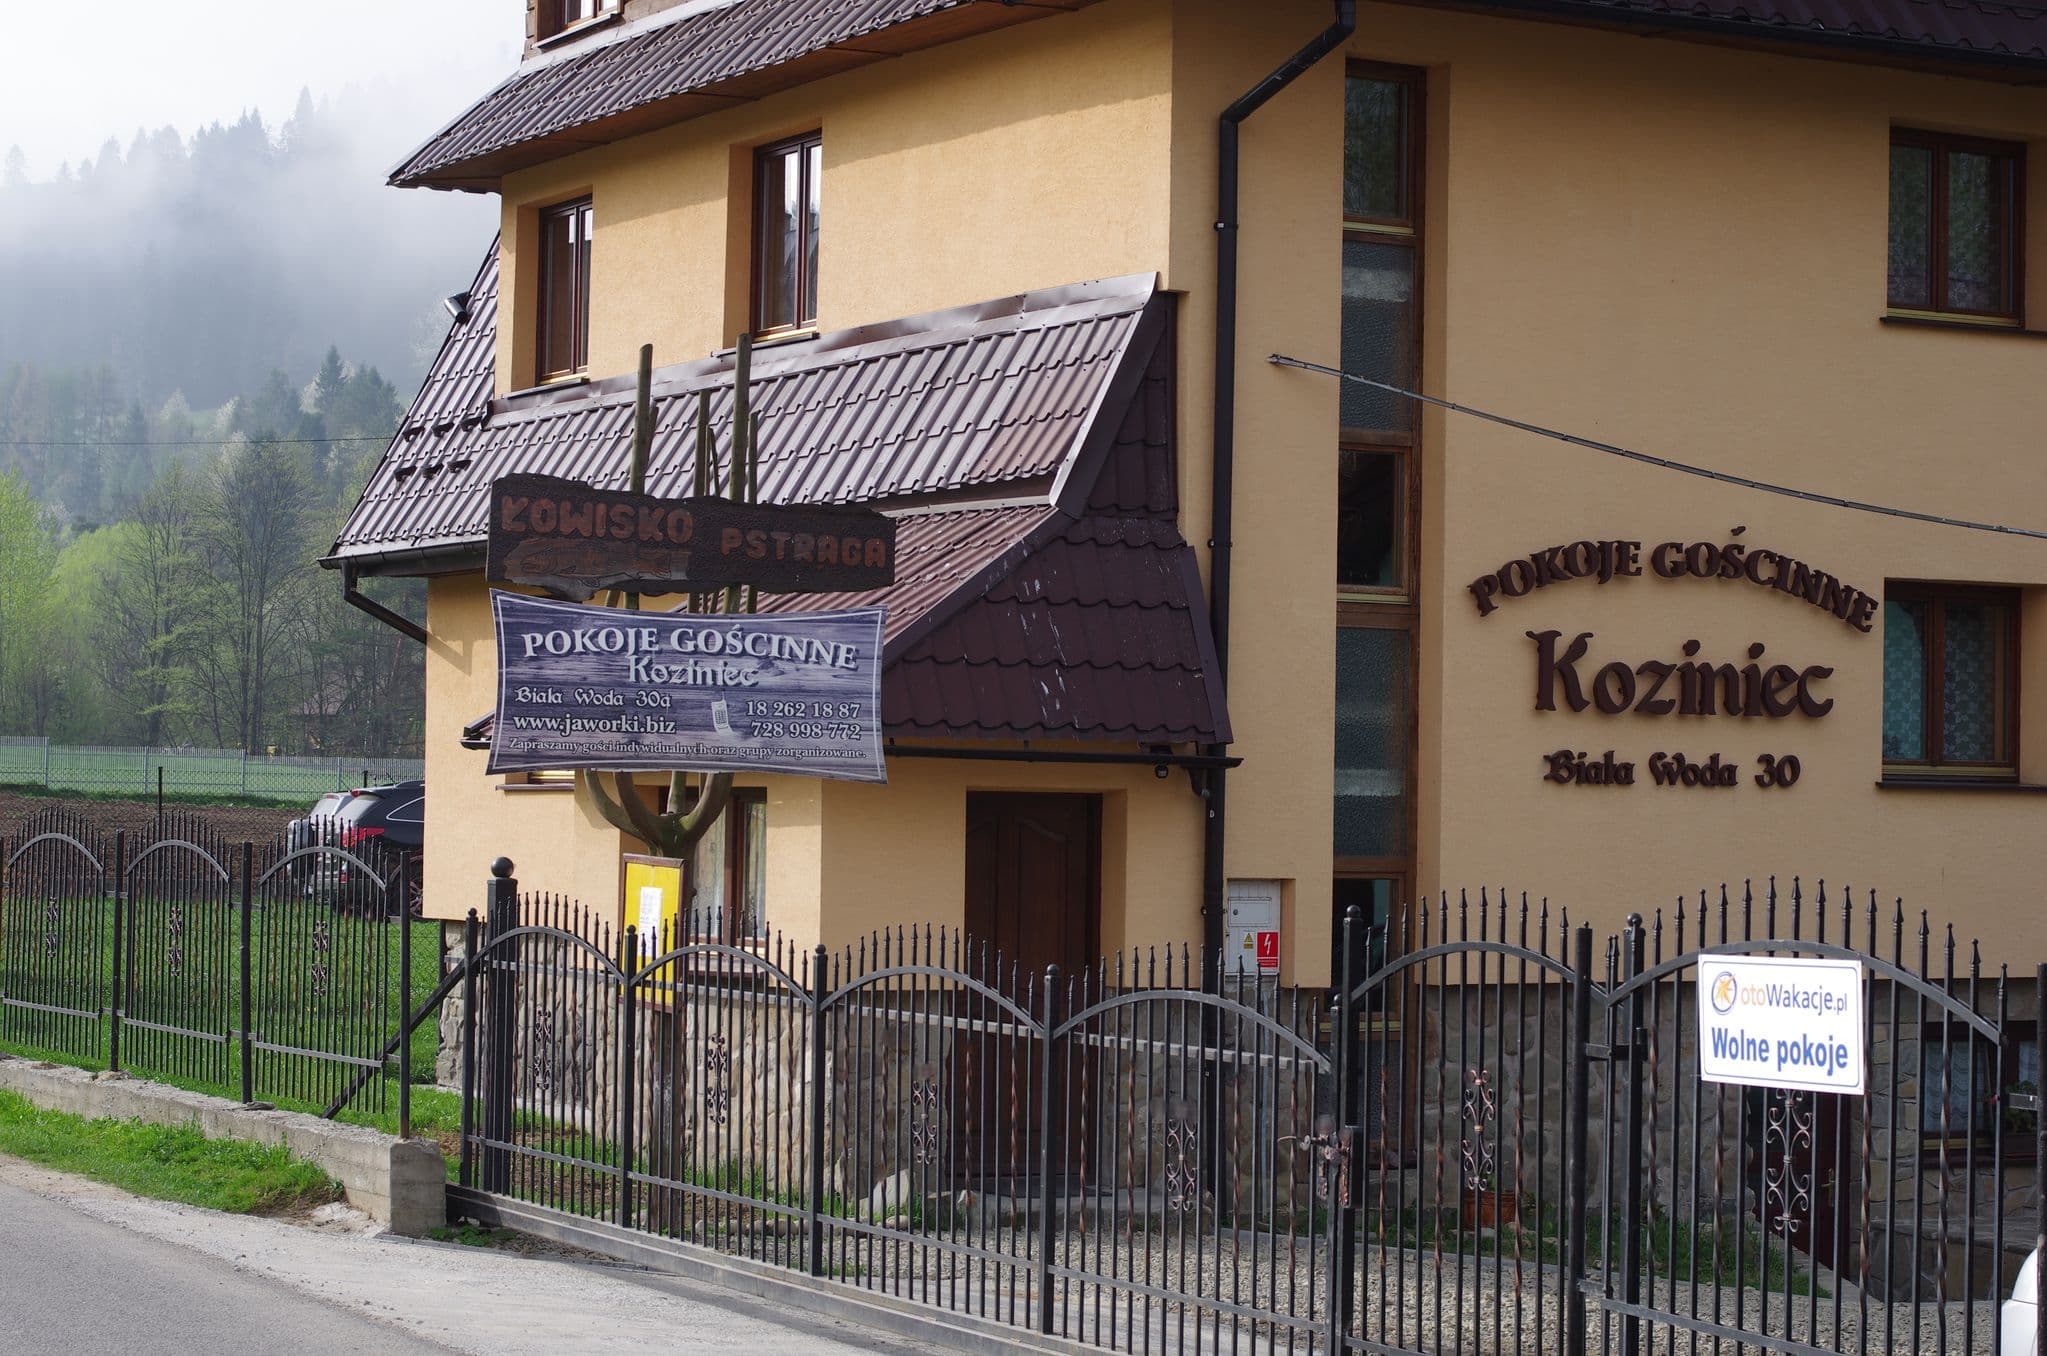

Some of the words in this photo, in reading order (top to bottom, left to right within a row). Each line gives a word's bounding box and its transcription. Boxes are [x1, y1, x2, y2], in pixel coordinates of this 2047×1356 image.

[1467, 540, 1643, 617] POKOJE
[1650, 526, 1879, 633] GOŚCINNE
[521, 627, 660, 658] POKOJE
[670, 624, 859, 670] GOŚCINNE
[626, 655, 758, 687] Koziniec
[1525, 629, 1834, 718] Koziniec
[574, 688, 624, 706] Woda
[635, 690, 672, 709] 30a
[746, 700, 768, 717] 18
[773, 701, 806, 718] 262
[812, 702, 833, 718] 18
[838, 702, 861, 719] 87
[513, 713, 677, 736] www.jaworki.biz
[751, 720, 784, 738] 728
[789, 722, 823, 739] 998
[828, 723, 862, 740] 772
[509, 737, 582, 753] Zapraszamy
[582, 740, 613, 754] gości
[616, 742, 707, 757] indywidualnych
[710, 745, 736, 755] oraz
[739, 747, 773, 758] grupy
[776, 746, 867, 760] zorganizowane.
[1648, 751, 1740, 788] Woda
[1754, 753, 1801, 788] 30
[1740, 983, 1848, 1016] otoWakacje.pl
[1711, 1027, 1769, 1063] Wolne
[1777, 1033, 1848, 1077] pokoje
